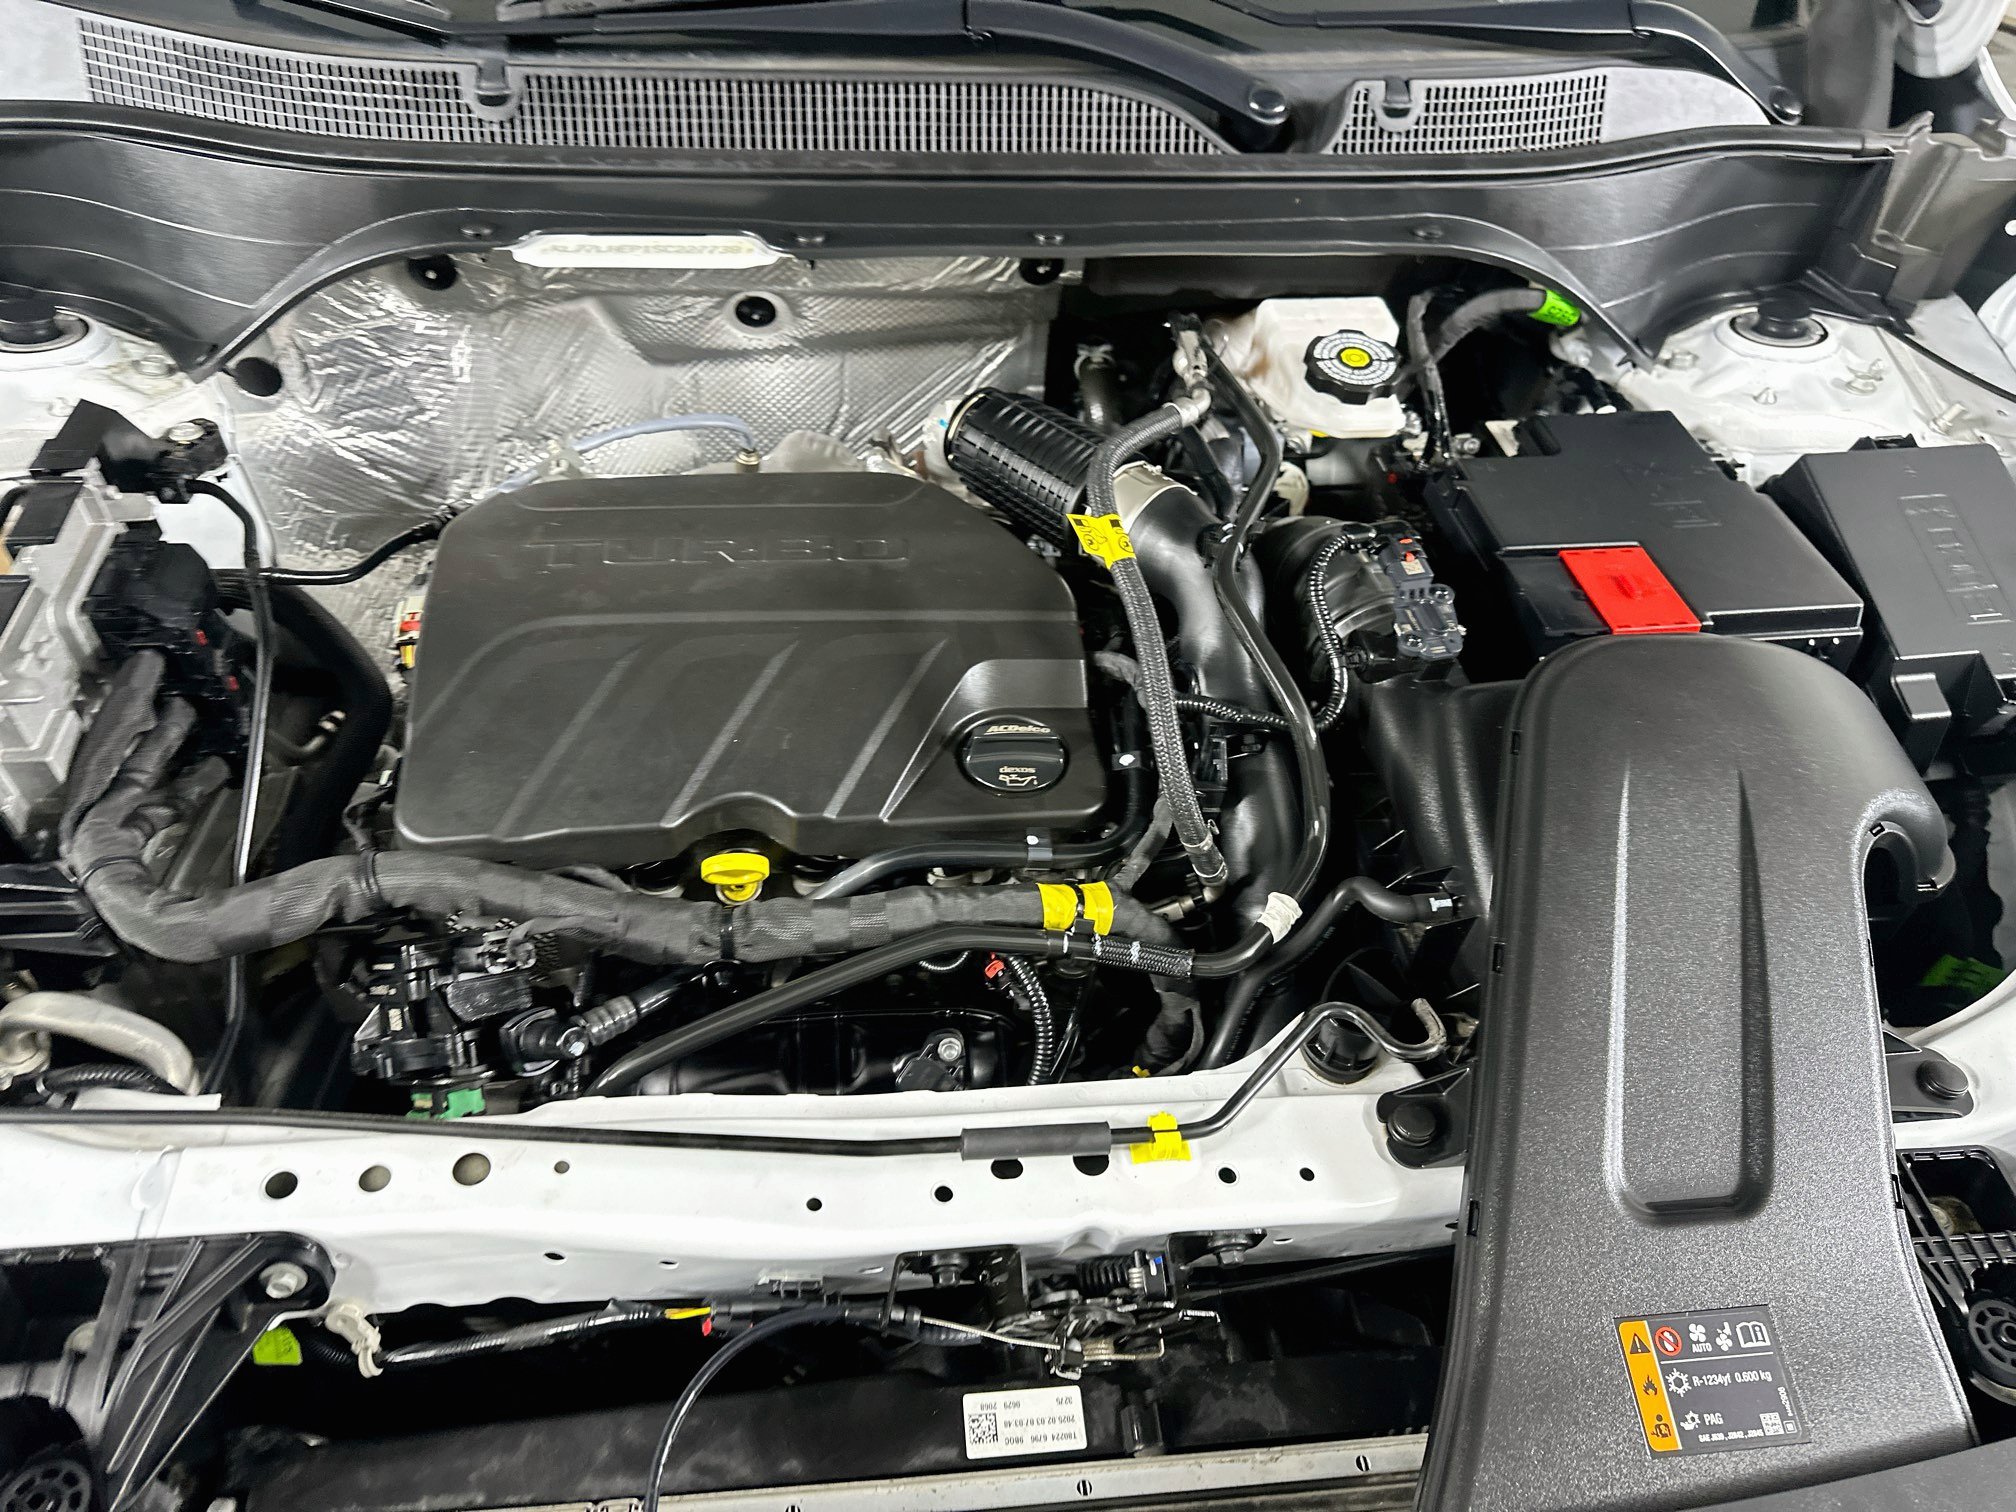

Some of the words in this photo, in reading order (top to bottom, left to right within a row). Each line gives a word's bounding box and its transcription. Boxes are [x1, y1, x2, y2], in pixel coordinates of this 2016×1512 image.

[519, 537, 909, 567] TURBO
[986, 724, 1051, 733] ACDelco
[999, 766, 1036, 774] dexos
[1692, 1342, 1712, 1353] AUTO
[1692, 1372, 1731, 1386] R-1234yf
[1734, 1370, 1759, 1383] 0.600
[1759, 1369, 1773, 1382] kg
[1703, 1412, 1724, 1425] PAG
